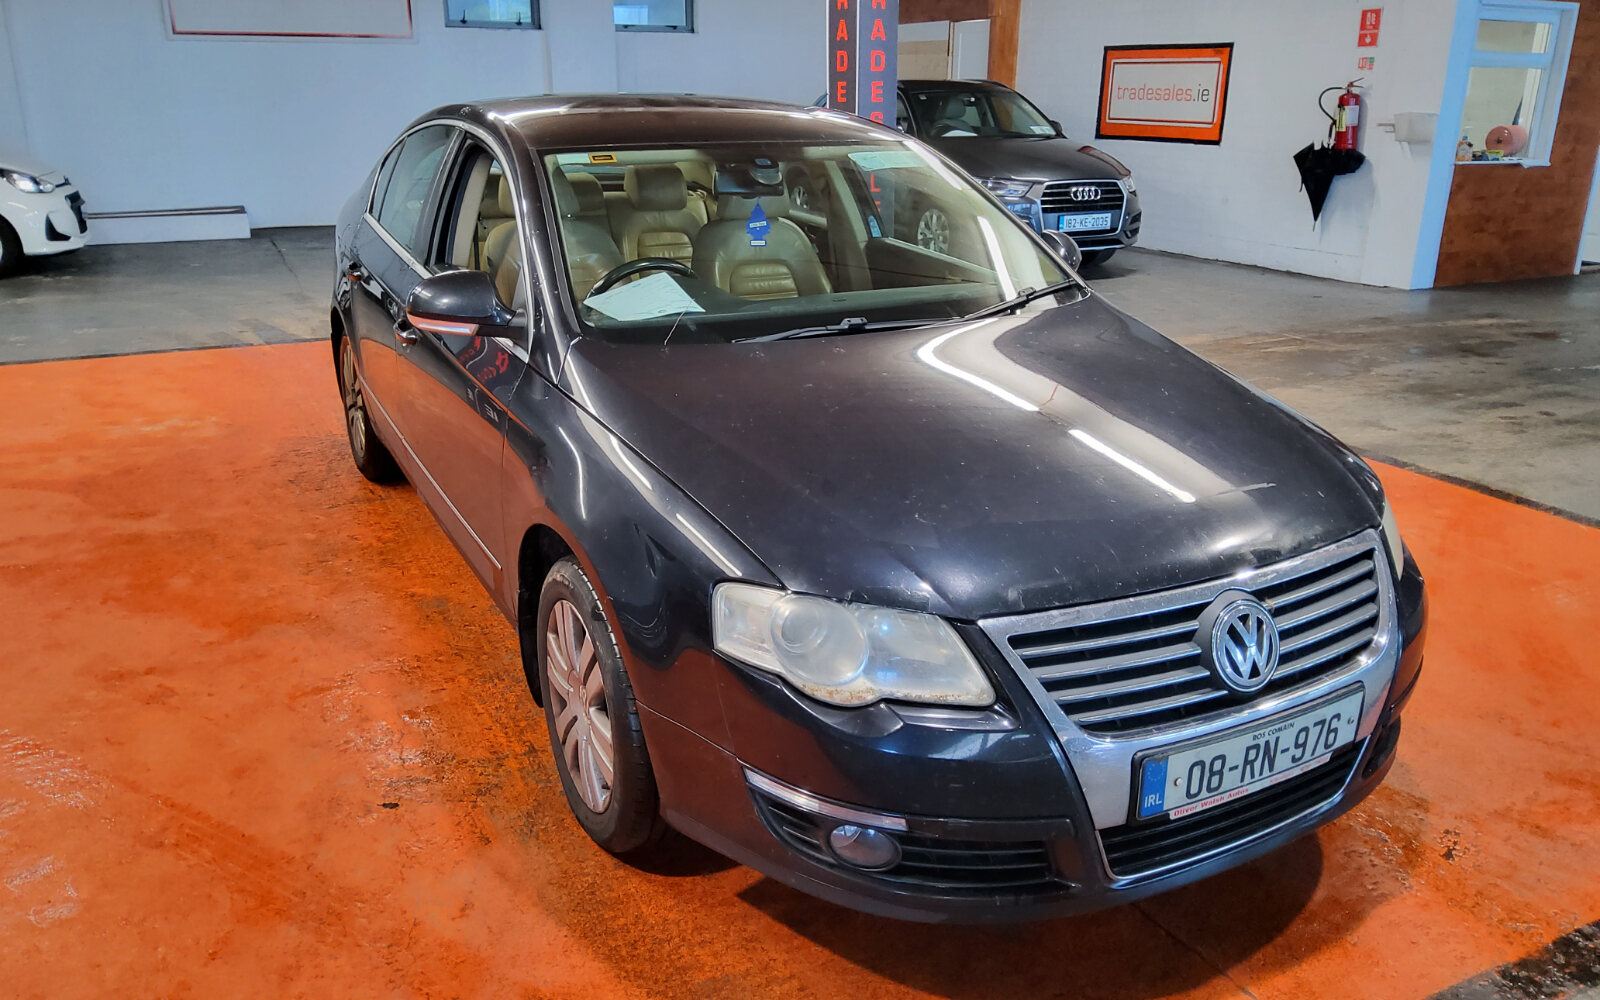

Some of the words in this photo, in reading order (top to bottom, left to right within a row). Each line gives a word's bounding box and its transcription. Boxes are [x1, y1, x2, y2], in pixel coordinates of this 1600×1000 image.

[1116, 83, 1210, 102] tradesales.ie
[1065, 216, 1109, 229] 182-KE-2035
[1185, 712, 1342, 800] 08-RN-976
[1144, 793, 1163, 808] IRL
[1173, 805, 1199, 817] Oliver
[1200, 796, 1225, 809] Walsh
[1227, 788, 1249, 800] Autos
